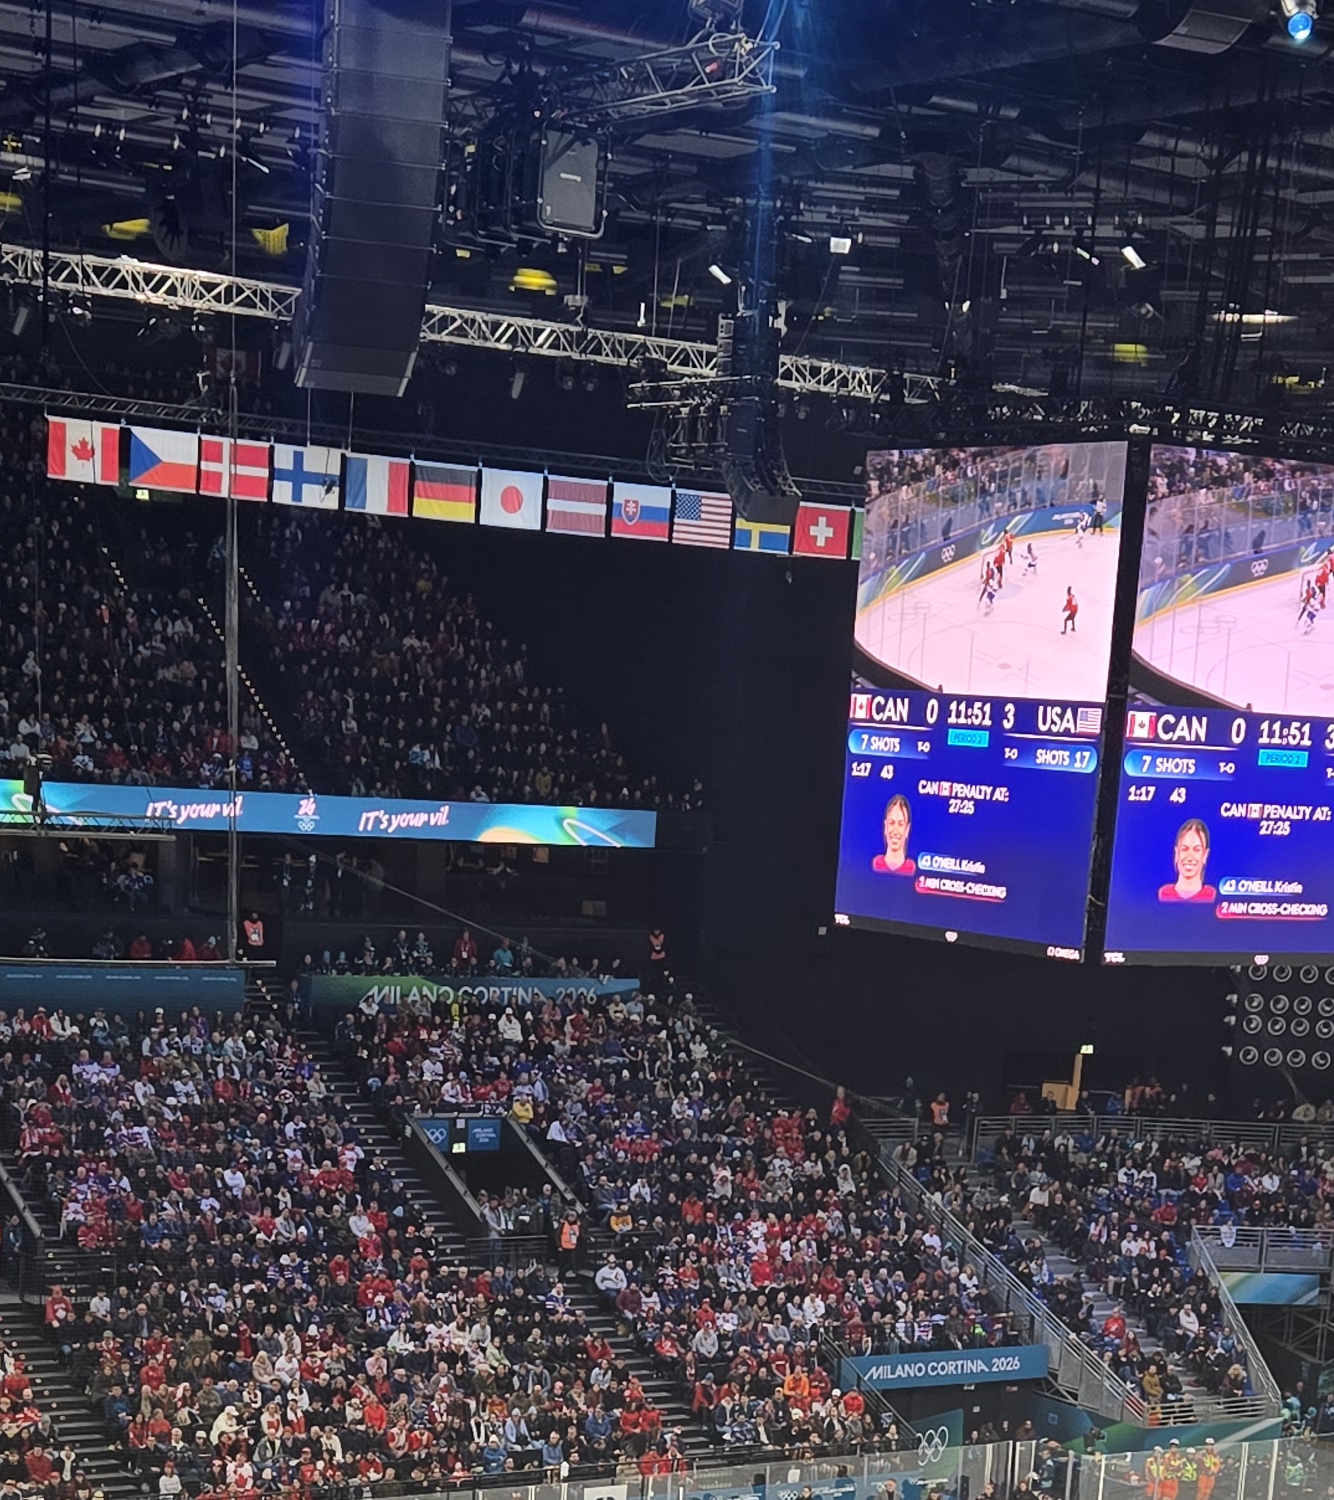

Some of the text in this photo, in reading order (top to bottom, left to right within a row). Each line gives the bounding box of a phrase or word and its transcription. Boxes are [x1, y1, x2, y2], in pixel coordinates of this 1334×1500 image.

[872, 696, 908, 722] CAN
[926, 699, 938, 723] 0
[947, 700, 991, 726] 11:51
[1003, 703, 1015, 729] 3
[1038, 706, 1075, 733] USA
[1157, 714, 1207, 742] CAN
[953, 732, 975, 744] PERIOD
[1231, 718, 1246, 743] 0
[1258, 720, 1312, 746] 11:51
[861, 734, 900, 752] 7 SHOTS
[1036, 749, 1090, 768] SHOTS 17
[1142, 756, 1195, 774] 7 SHOTS
[1266, 752, 1292, 764] PERIOD
[851, 762, 871, 777] 1:17
[880, 765, 893, 779] 43
[918, 780, 1009, 802] CAN PENALTY AT:
[1128, 784, 1155, 801] 1:17
[1169, 787, 1186, 803] 43
[146, 800, 176, 818] IT's
[176, 803, 220, 824] your
[949, 799, 974, 814] 27:25
[1220, 803, 1332, 821] CAN PENALTY AT:
[358, 805, 449, 833] IT's your vil
[1259, 821, 1290, 836] 27:25
[940, 879, 1006, 898] CROSS-CHECKING
[1221, 902, 1327, 917] 2 MIN CROSS-CHECKING
[864, 1356, 1020, 1380] MILANO CORTINA 2026
